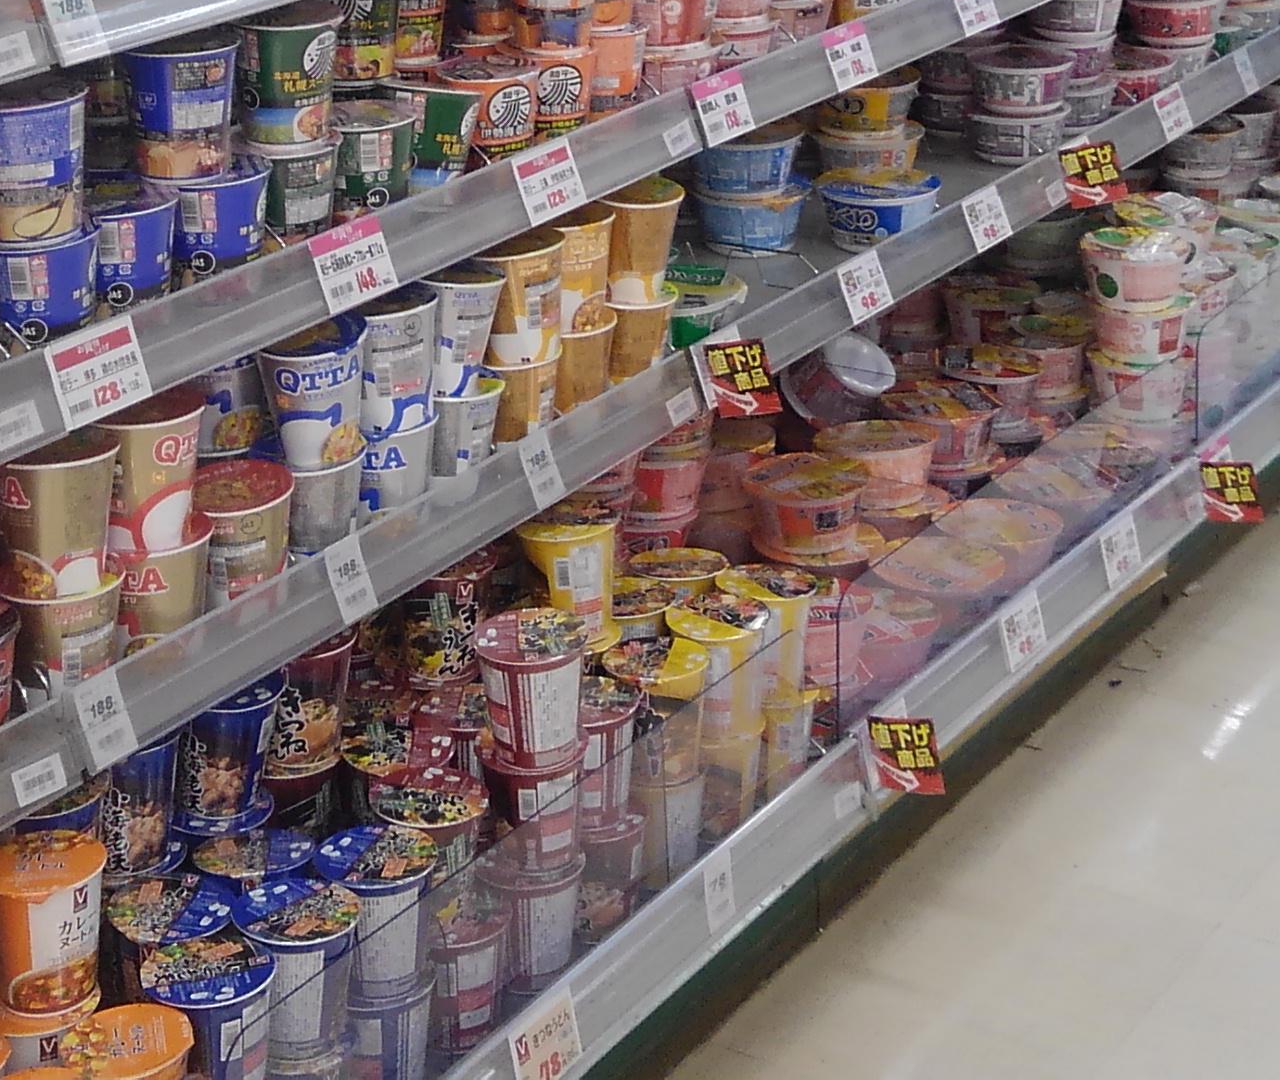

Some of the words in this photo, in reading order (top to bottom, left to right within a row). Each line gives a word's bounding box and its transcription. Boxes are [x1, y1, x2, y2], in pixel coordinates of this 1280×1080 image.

[547, 188, 569, 209] 128
[982, 223, 999, 240] 98
[355, 266, 378, 294] 148
[860, 290, 879, 310] 98
[275, 354, 361, 395] QTTA
[92, 380, 123, 408] 128
[152, 433, 199, 466] QT
[361, 446, 409, 472] TA
[120, 566, 169, 596] TA
[58, 910, 98, 936] カレー
